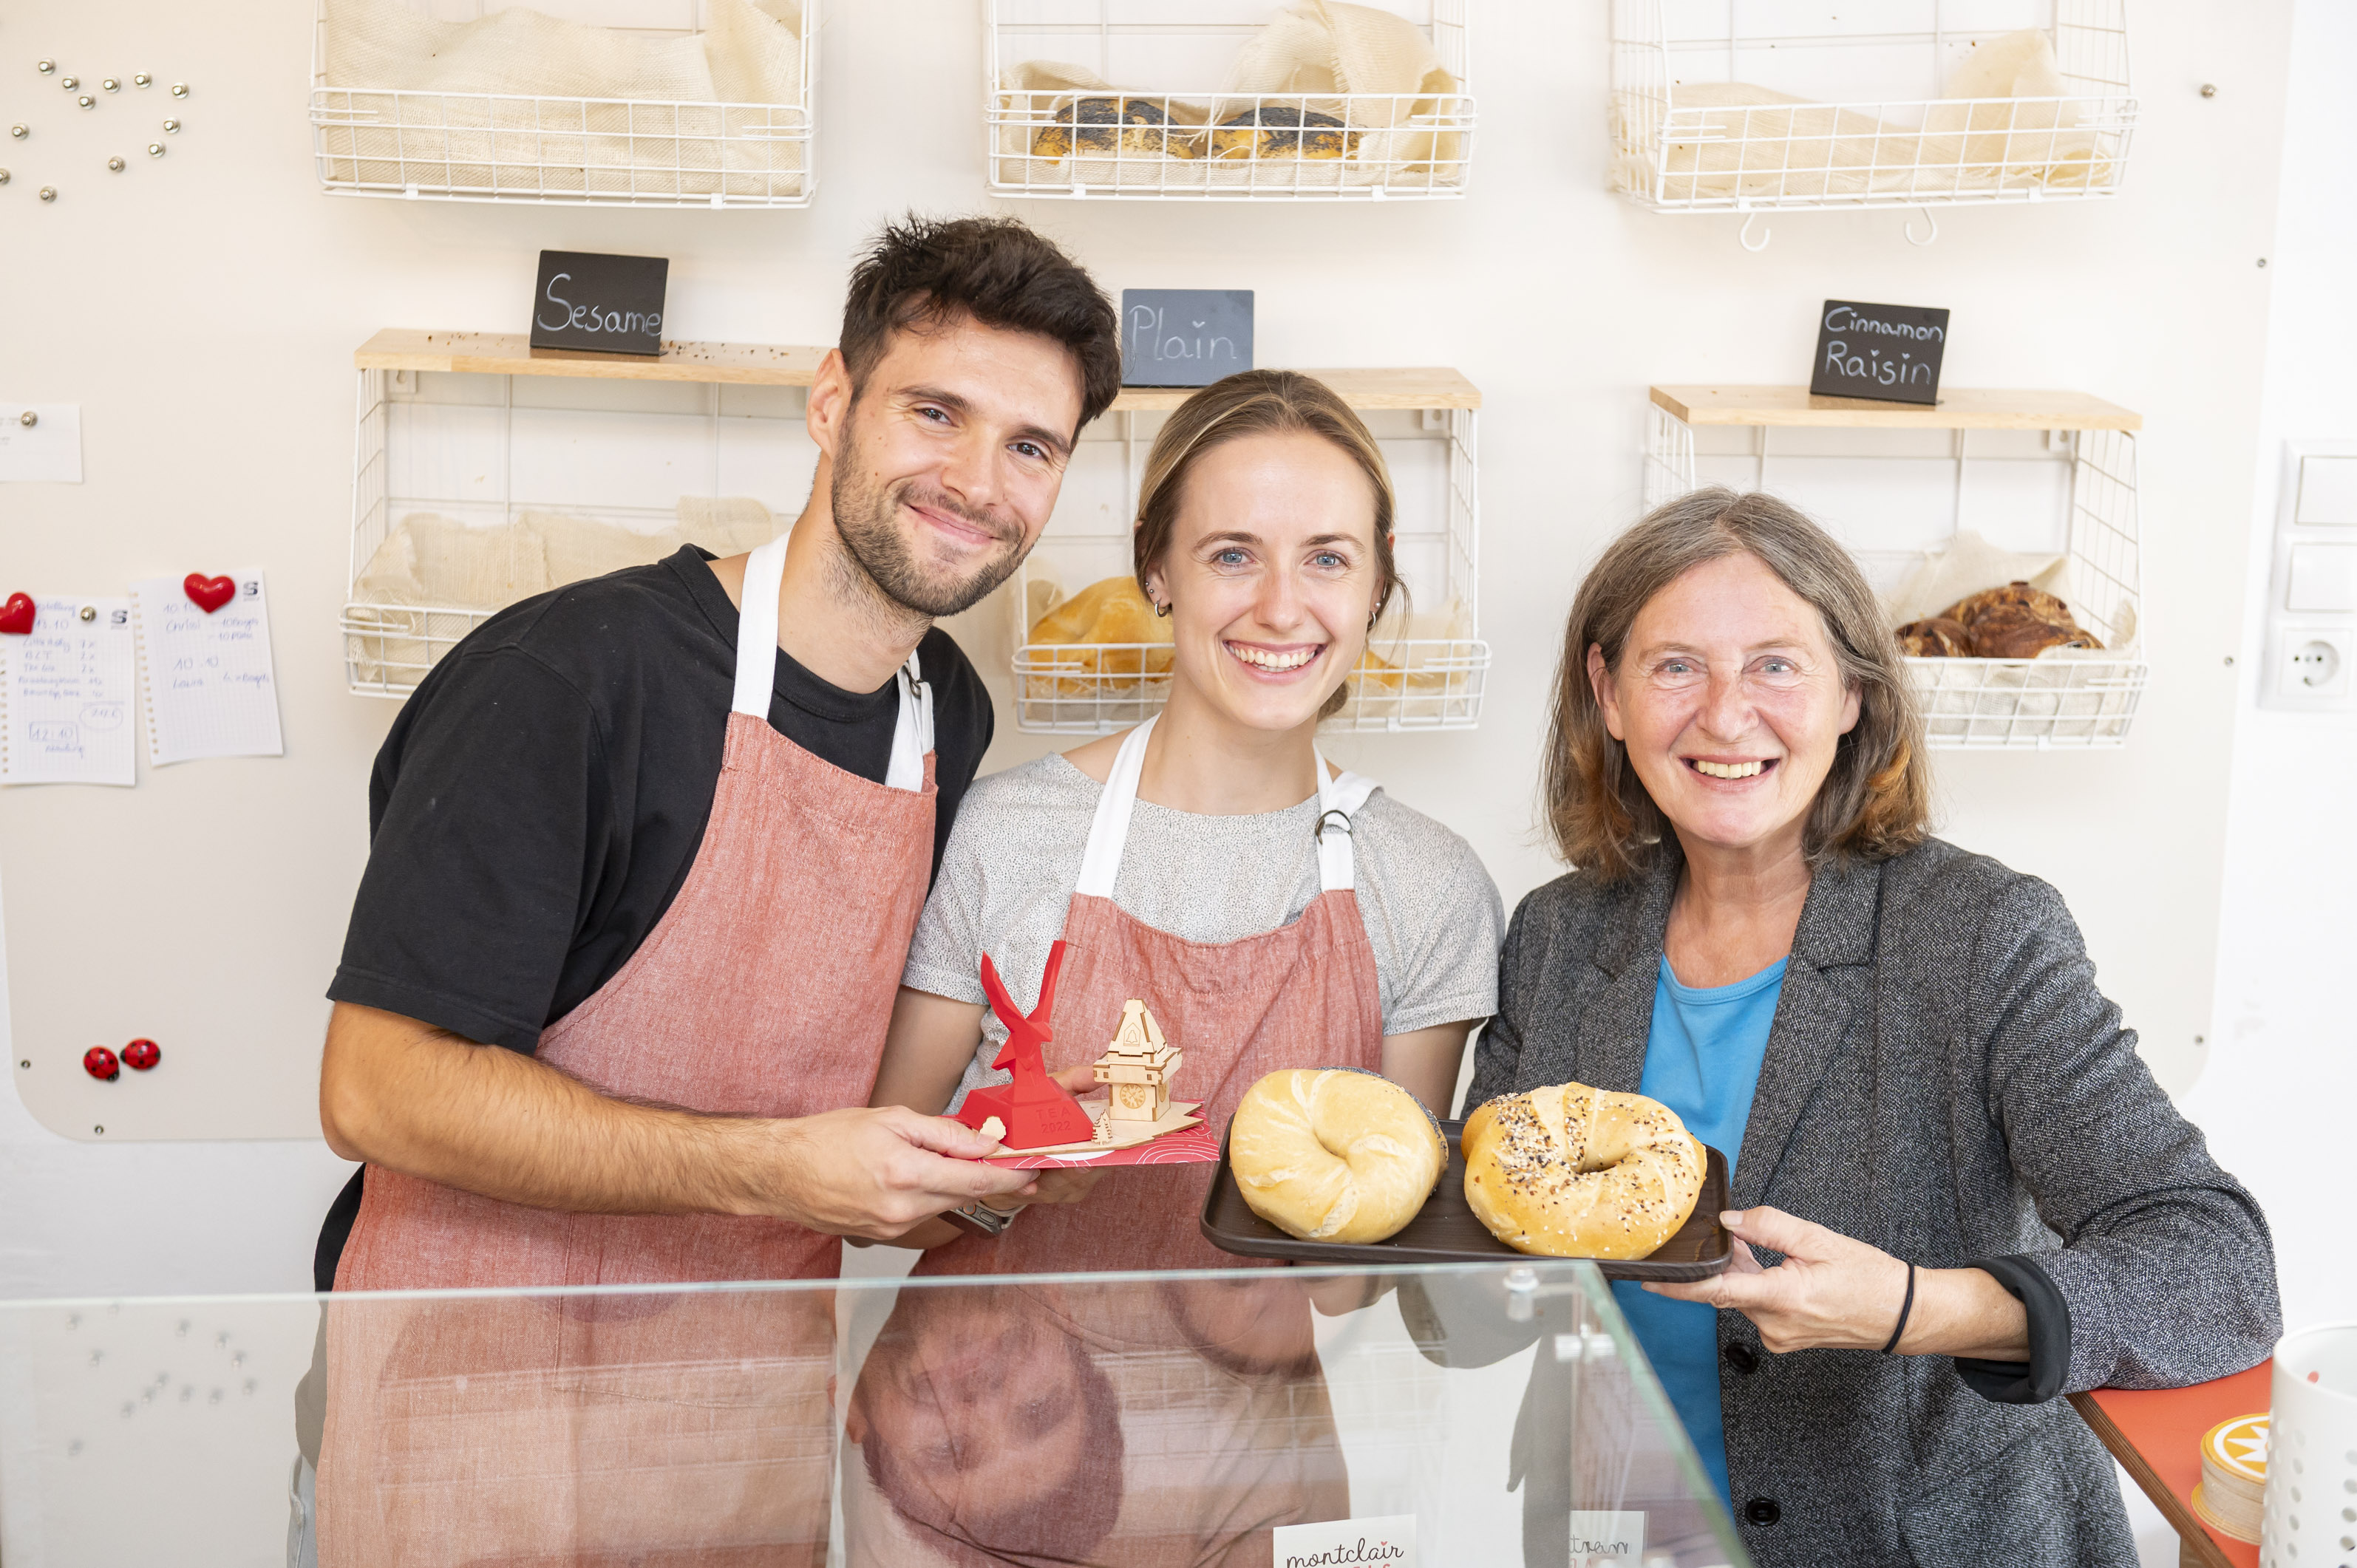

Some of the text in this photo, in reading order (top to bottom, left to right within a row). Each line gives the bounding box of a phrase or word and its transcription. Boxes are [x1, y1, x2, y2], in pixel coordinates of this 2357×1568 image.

[537, 273, 661, 337] Sesame
[1129, 304, 1237, 361] Plain
[1825, 306, 1944, 344] Cinnamon
[1825, 340, 1931, 385] Raisin
[1035, 1106, 1072, 1119] TEA
[1041, 1120, 1072, 1134] 2022
[1287, 1537, 1404, 1568] montclair
